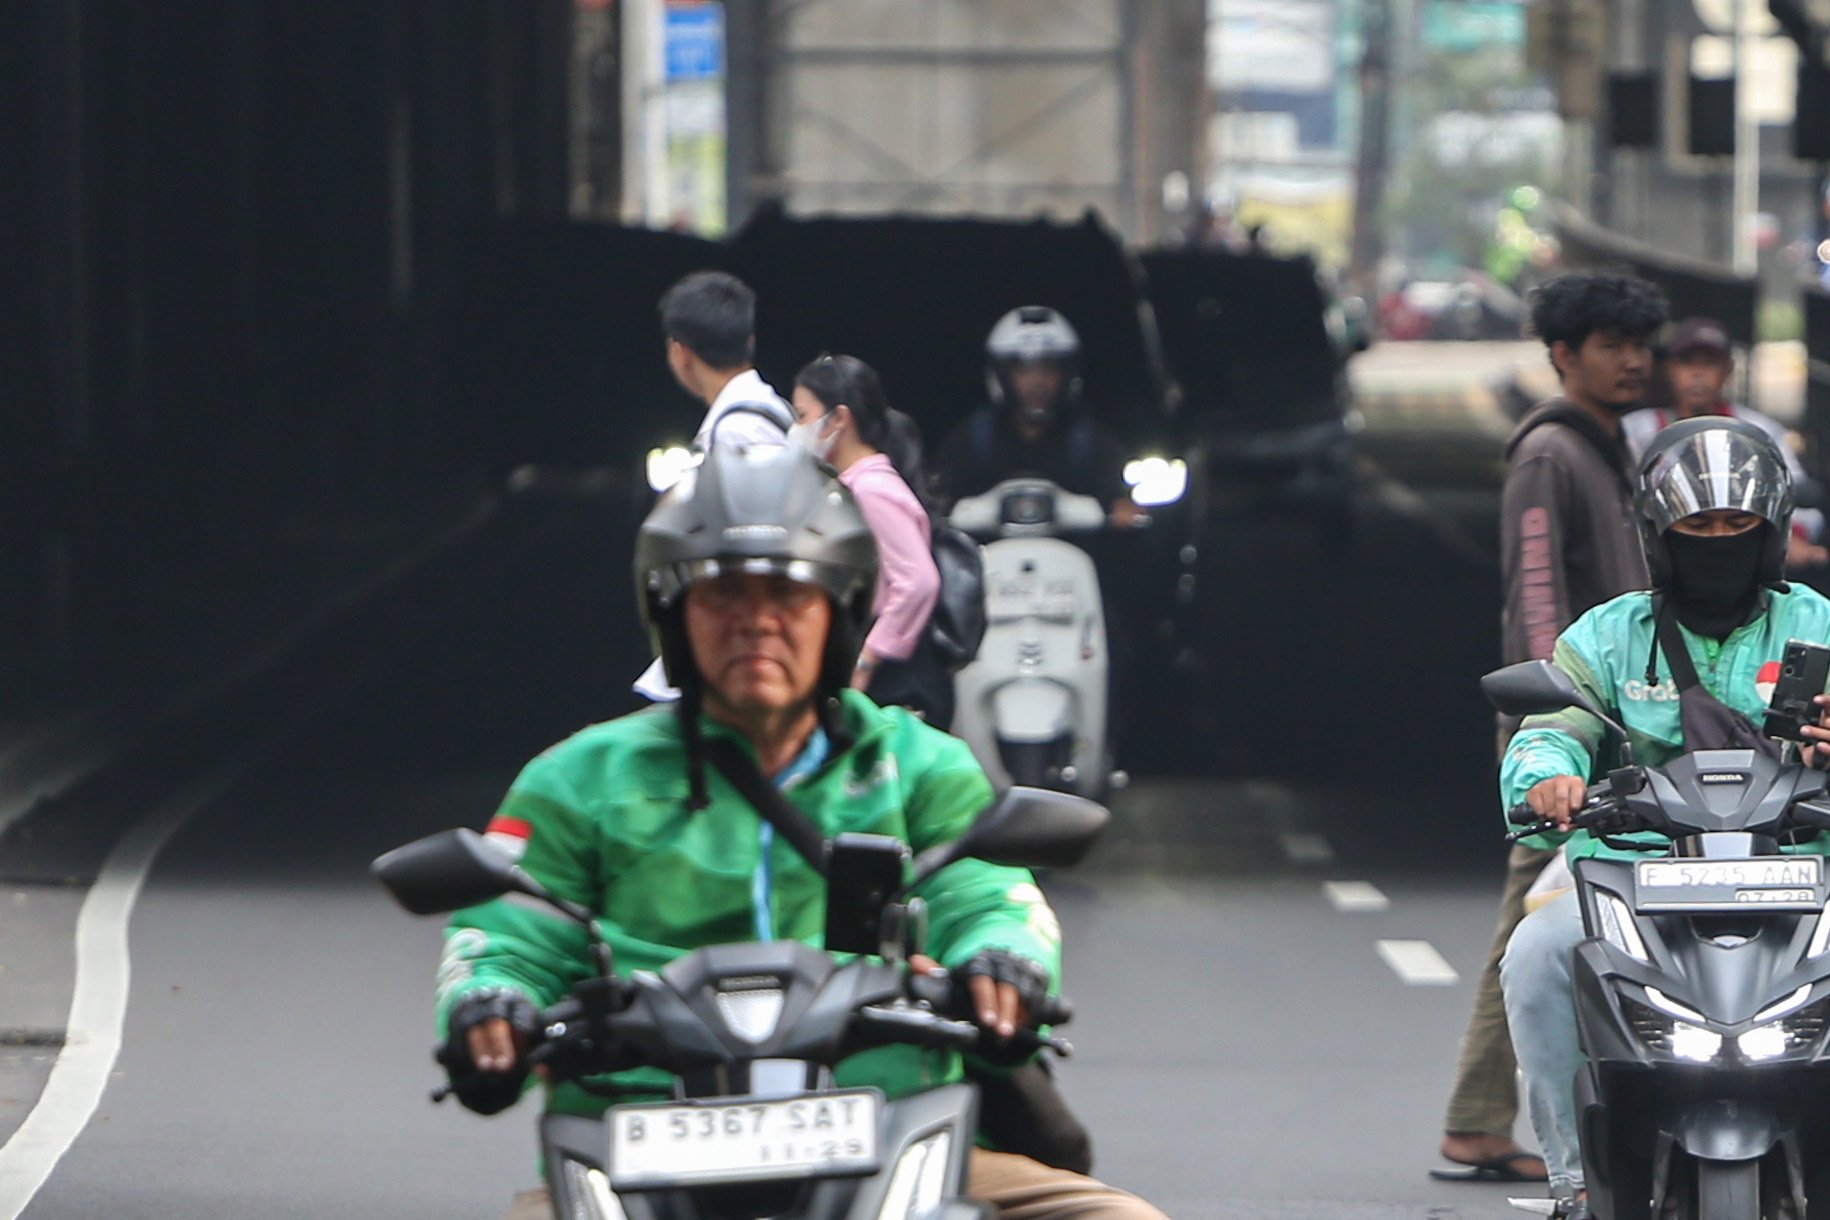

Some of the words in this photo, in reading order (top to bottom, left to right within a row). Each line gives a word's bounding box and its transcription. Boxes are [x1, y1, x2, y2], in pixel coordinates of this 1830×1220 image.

[1624, 677, 1680, 701] Grab
[1680, 866, 1746, 886] 5235
[1763, 865, 1811, 885] AAN
[626, 1113, 647, 1141] B
[670, 1105, 770, 1139] 5367
[786, 1099, 858, 1130] SAT
